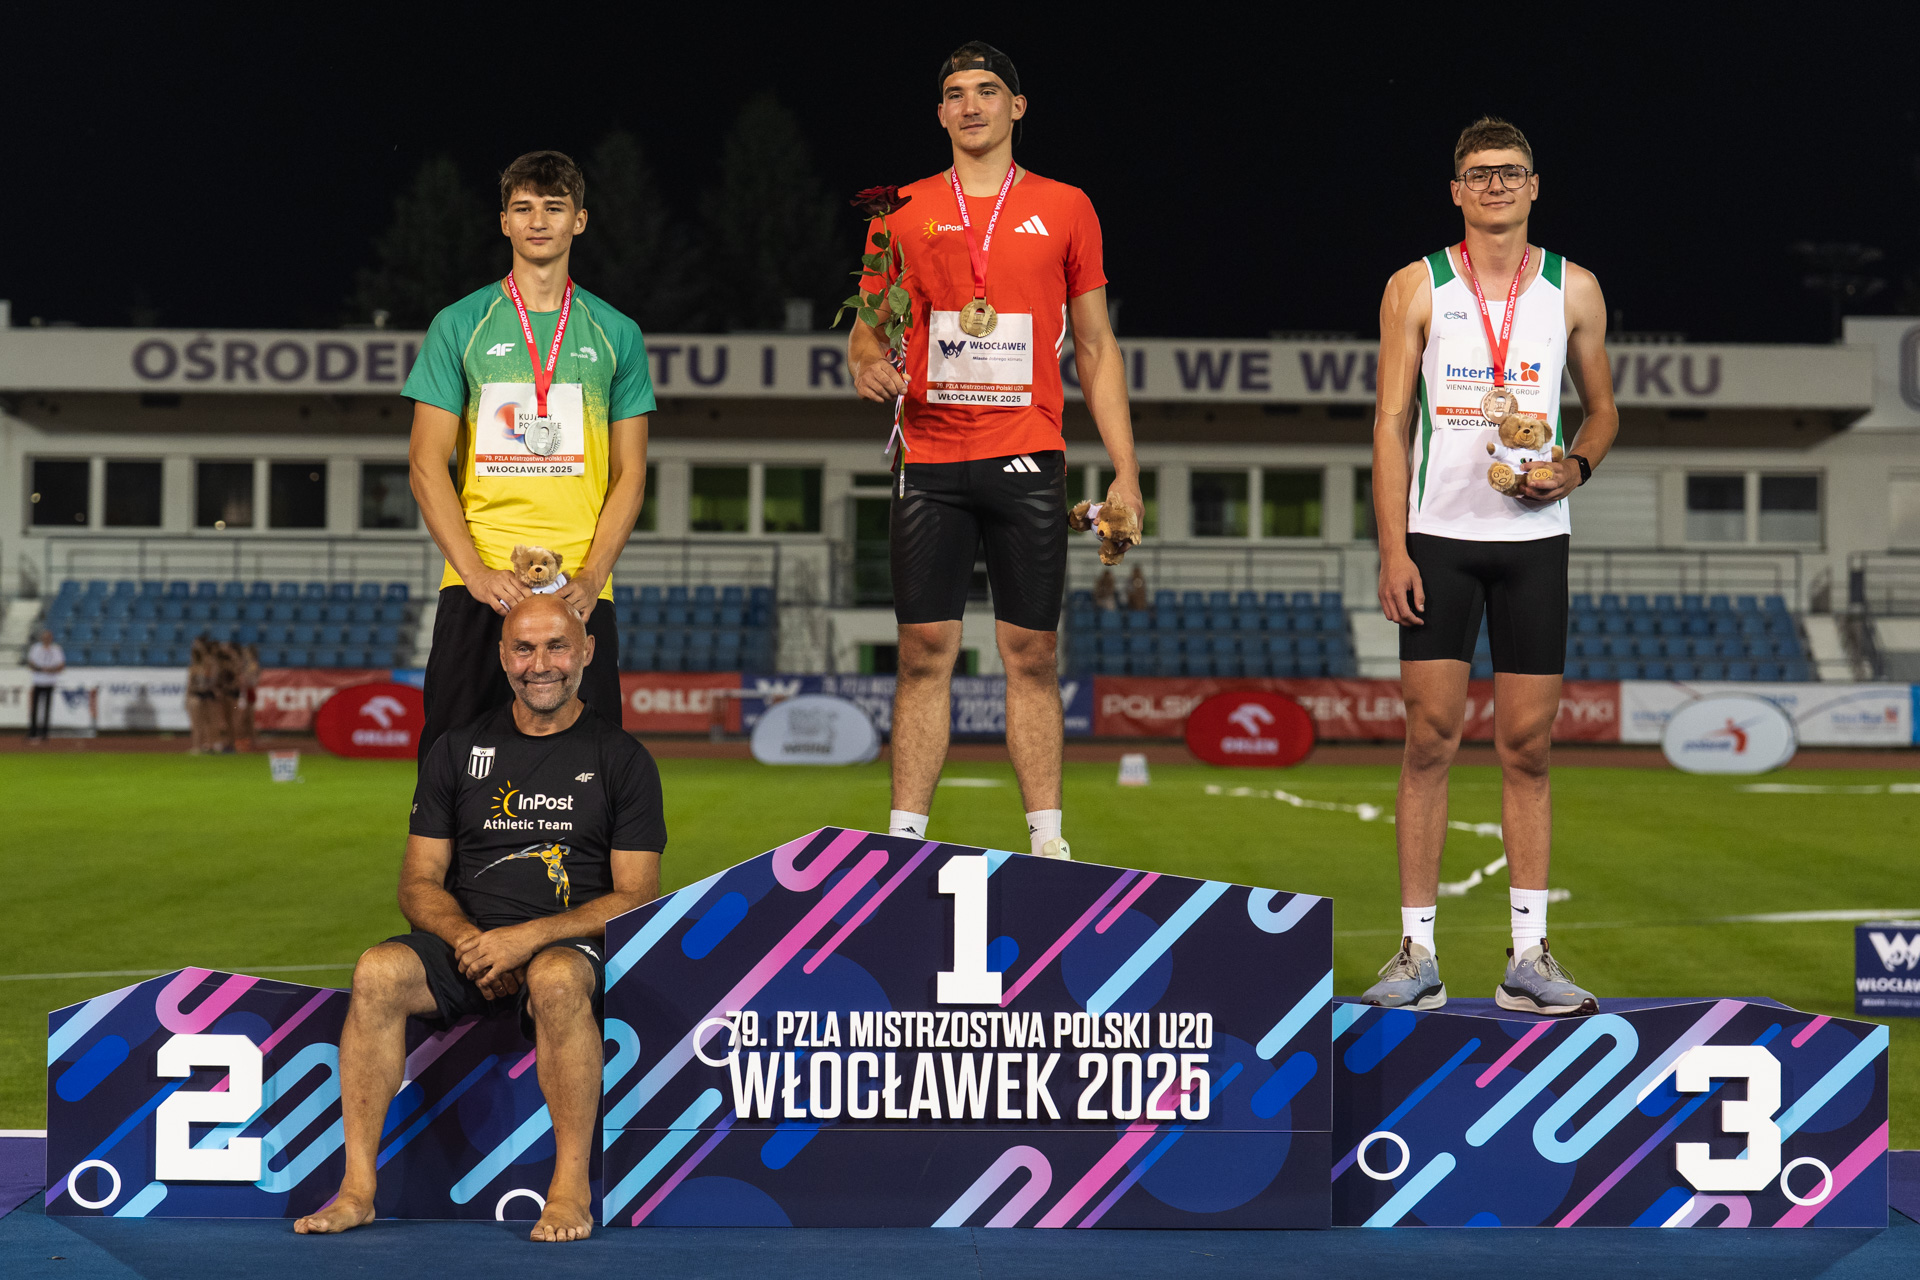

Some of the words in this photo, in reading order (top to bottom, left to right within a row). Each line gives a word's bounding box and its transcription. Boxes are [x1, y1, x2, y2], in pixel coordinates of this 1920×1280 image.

[987, 210, 999, 235] POLSKI
[982, 234, 991, 252] 2025
[1444, 311, 1468, 320] esa
[1505, 296, 1515, 321] POLSKI
[515, 298, 534, 344] MISTRZOSTWA
[1502, 320, 1511, 340] 2025
[486, 343, 516, 356] 4F
[552, 330, 563, 355] POLSKI
[970, 341, 1027, 350] WŁOCŁAWEK
[547, 355, 556, 372] 2025
[1175, 350, 1272, 392] WE
[1446, 364, 1518, 381] InterRsk
[937, 393, 998, 402] WŁOCŁAWEK
[1515, 388, 1540, 396] GROUP
[575, 772, 595, 782] 4F
[518, 793, 574, 811] InPost
[483, 818, 534, 831] Athletic
[538, 819, 573, 831] Team
[937, 855, 1003, 1004] 1
[726, 1010, 768, 1048] 79.
[776, 1010, 842, 1048] PZLA
[849, 1010, 1046, 1049] MISTRZOSTWA
[1053, 1011, 1150, 1049] POLSKI
[1159, 1012, 1214, 1049] U20
[728, 1051, 1061, 1121] WŁOCŁAWEK
[1077, 1053, 1211, 1121] 2025
[155, 1034, 264, 1182] 2
[1675, 1045, 1782, 1191] 3
